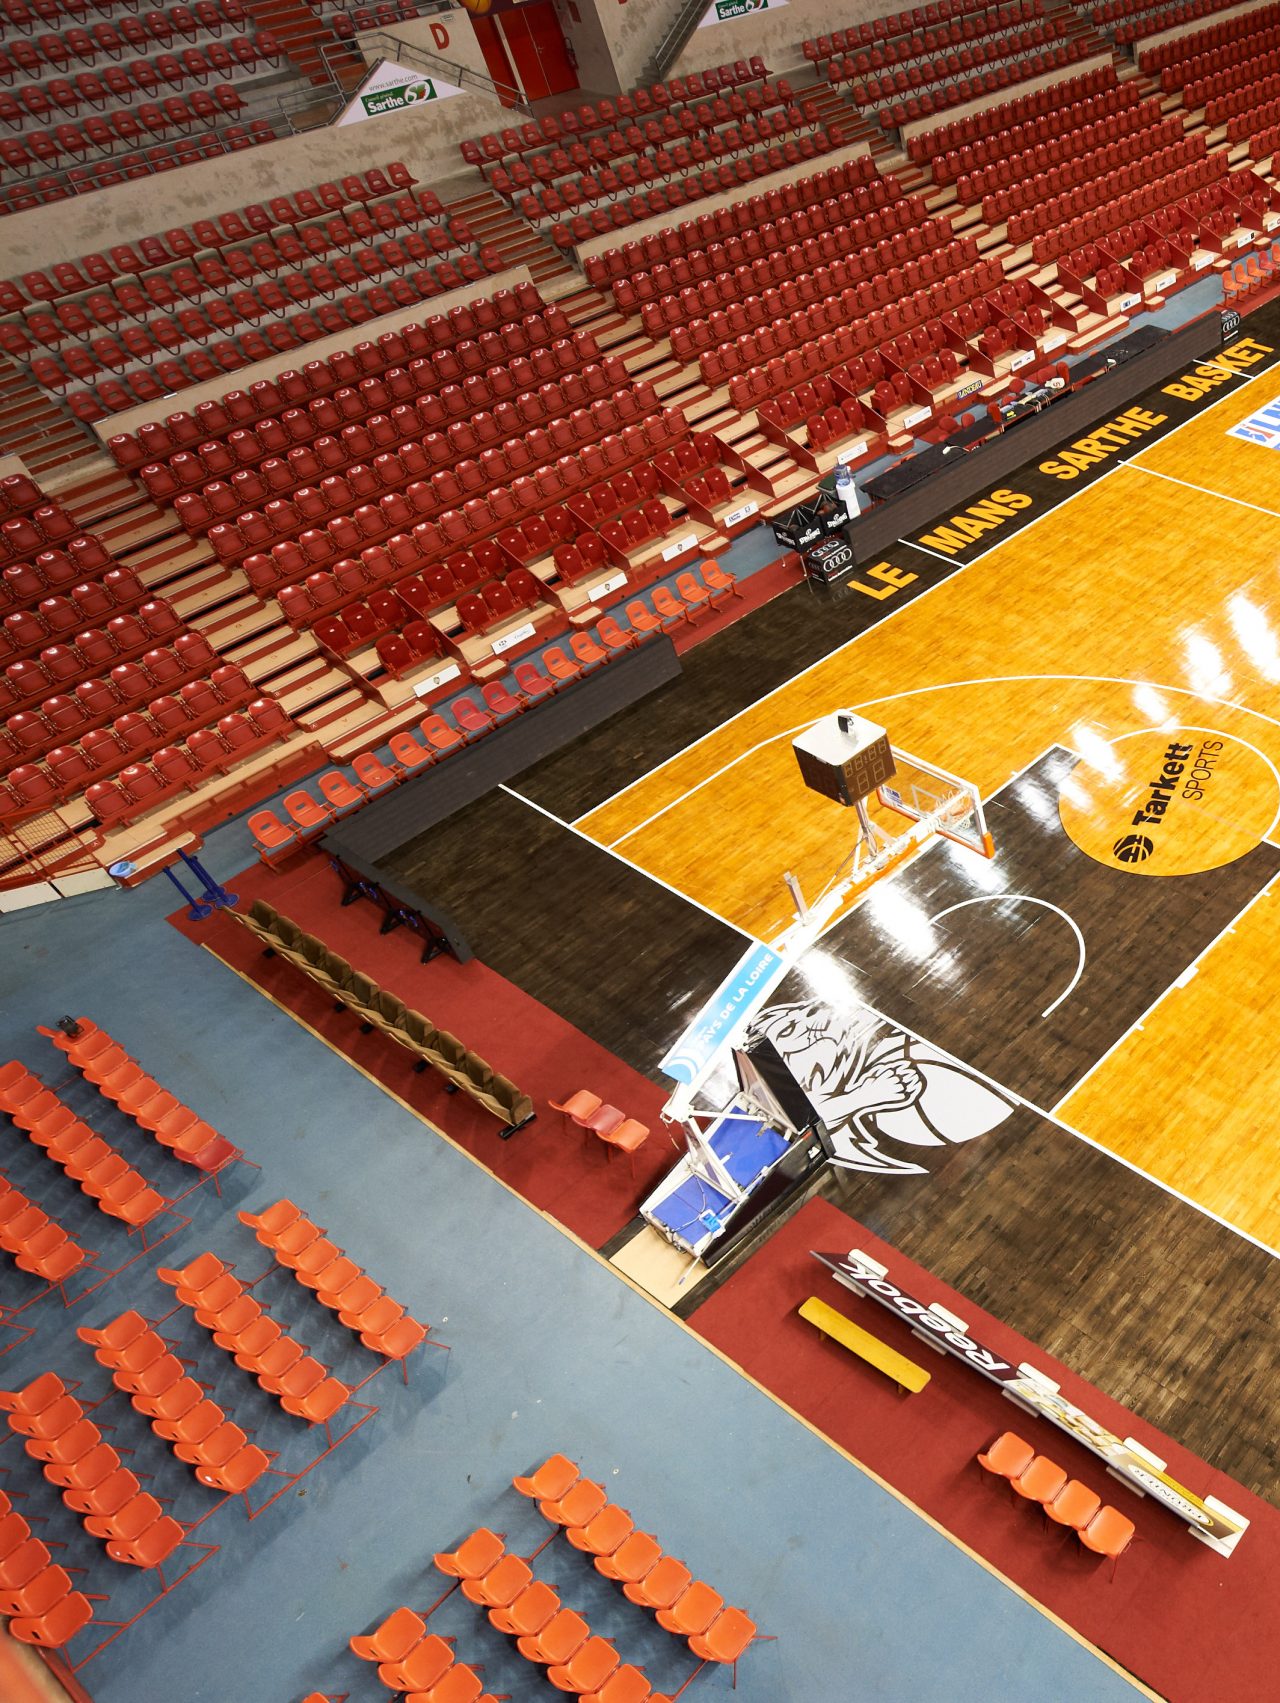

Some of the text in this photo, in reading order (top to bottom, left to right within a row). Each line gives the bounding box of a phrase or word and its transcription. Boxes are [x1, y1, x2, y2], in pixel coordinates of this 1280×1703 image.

[429, 23, 450, 50] D
[367, 96, 404, 113] Sarthe
[847, 338, 1273, 600] LE MANS SARTHE BASKET
[1131, 742, 1193, 826] Tarkett
[1182, 740, 1224, 801] SPORTS
[720, 1002, 736, 1020] DE
[732, 988, 749, 1003] LA
[745, 953, 774, 986] LOIRE
[839, 1261, 1011, 1373] Reebok
